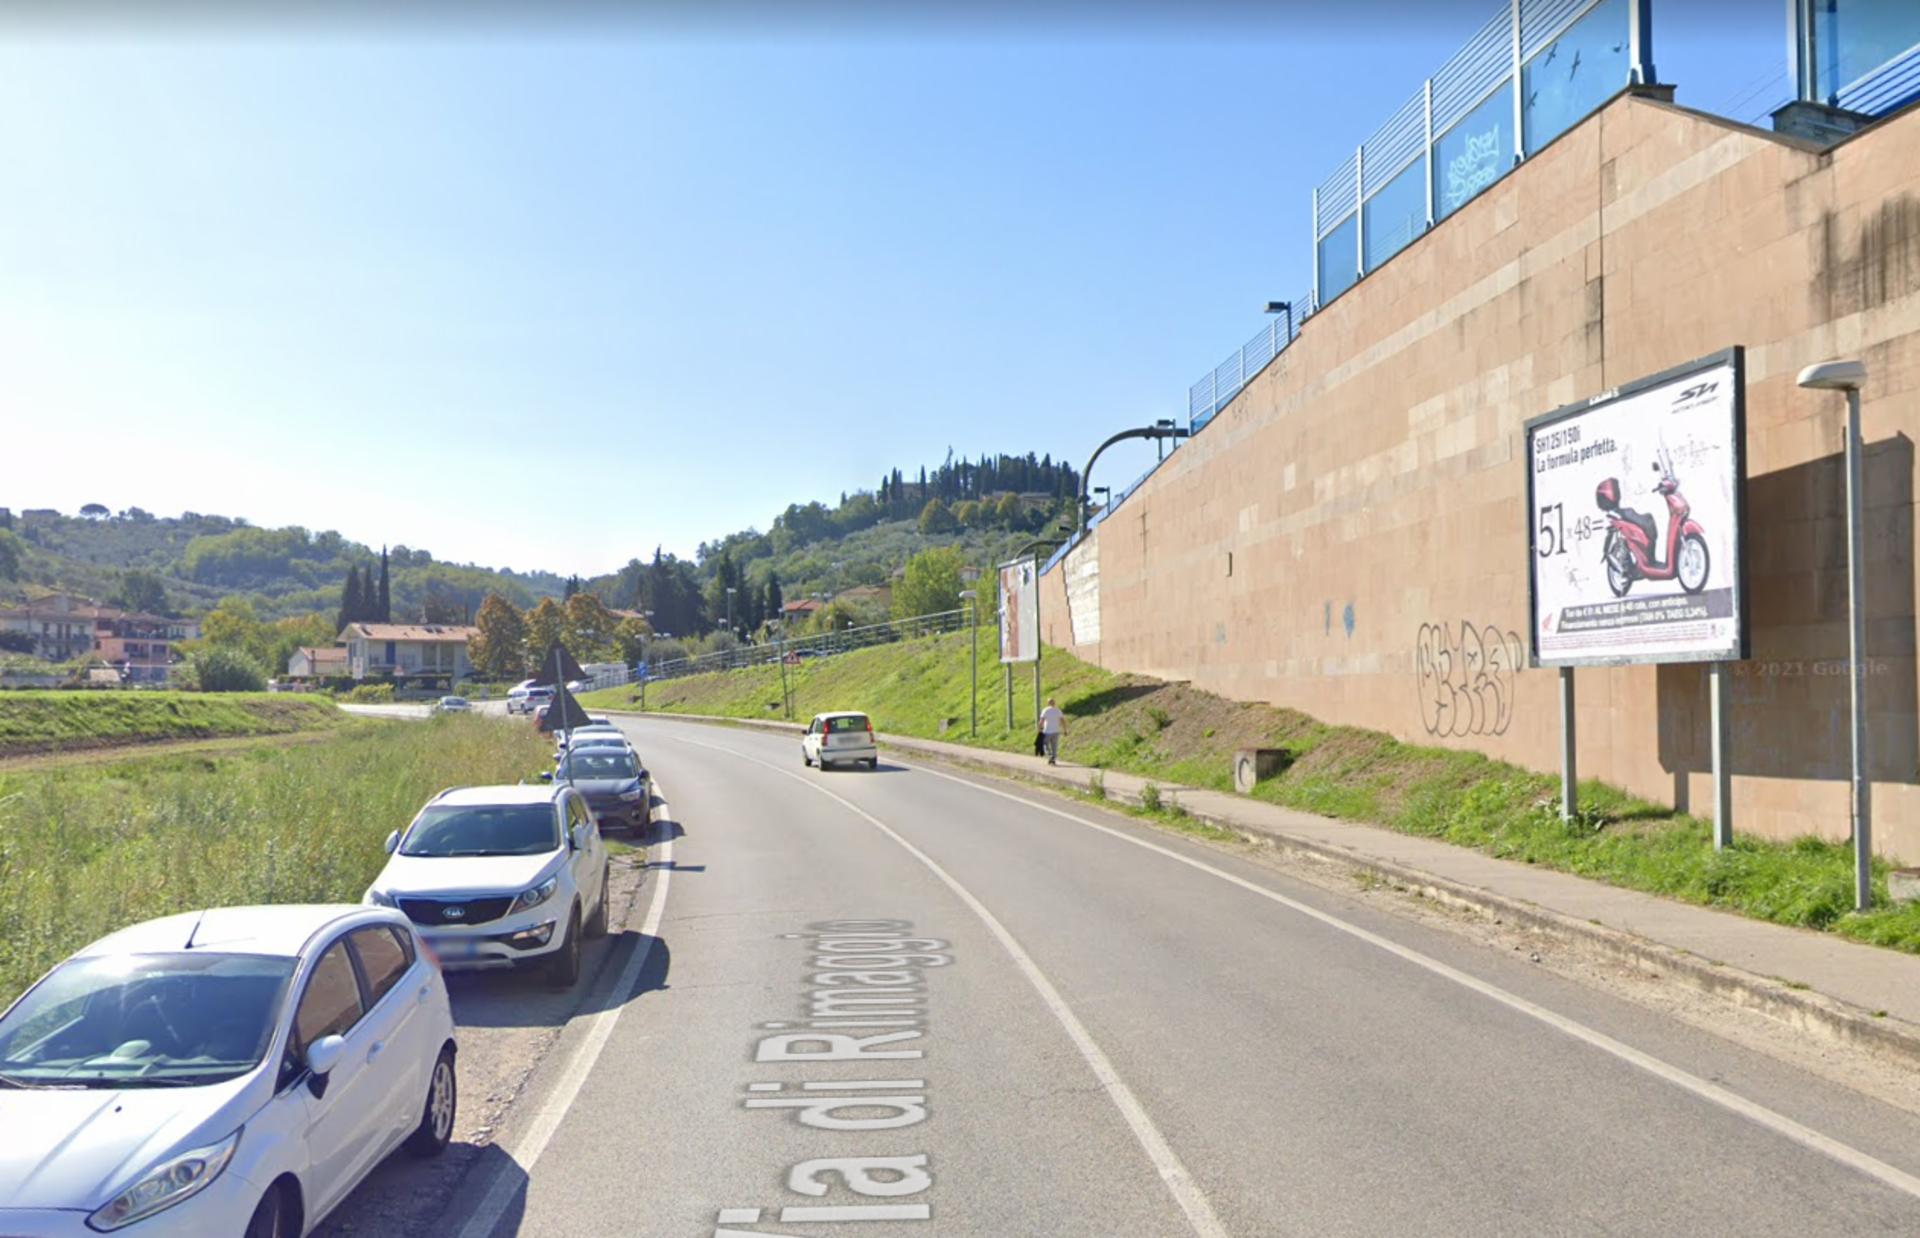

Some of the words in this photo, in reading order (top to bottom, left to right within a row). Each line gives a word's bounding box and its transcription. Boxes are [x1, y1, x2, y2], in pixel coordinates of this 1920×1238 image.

[1536, 424, 1581, 454] SH125/150i
[1536, 457, 1546, 474] La
[1547, 446, 1579, 470] formula
[1580, 438, 1618, 466] perfetta.
[1539, 501, 1568, 558] 51
